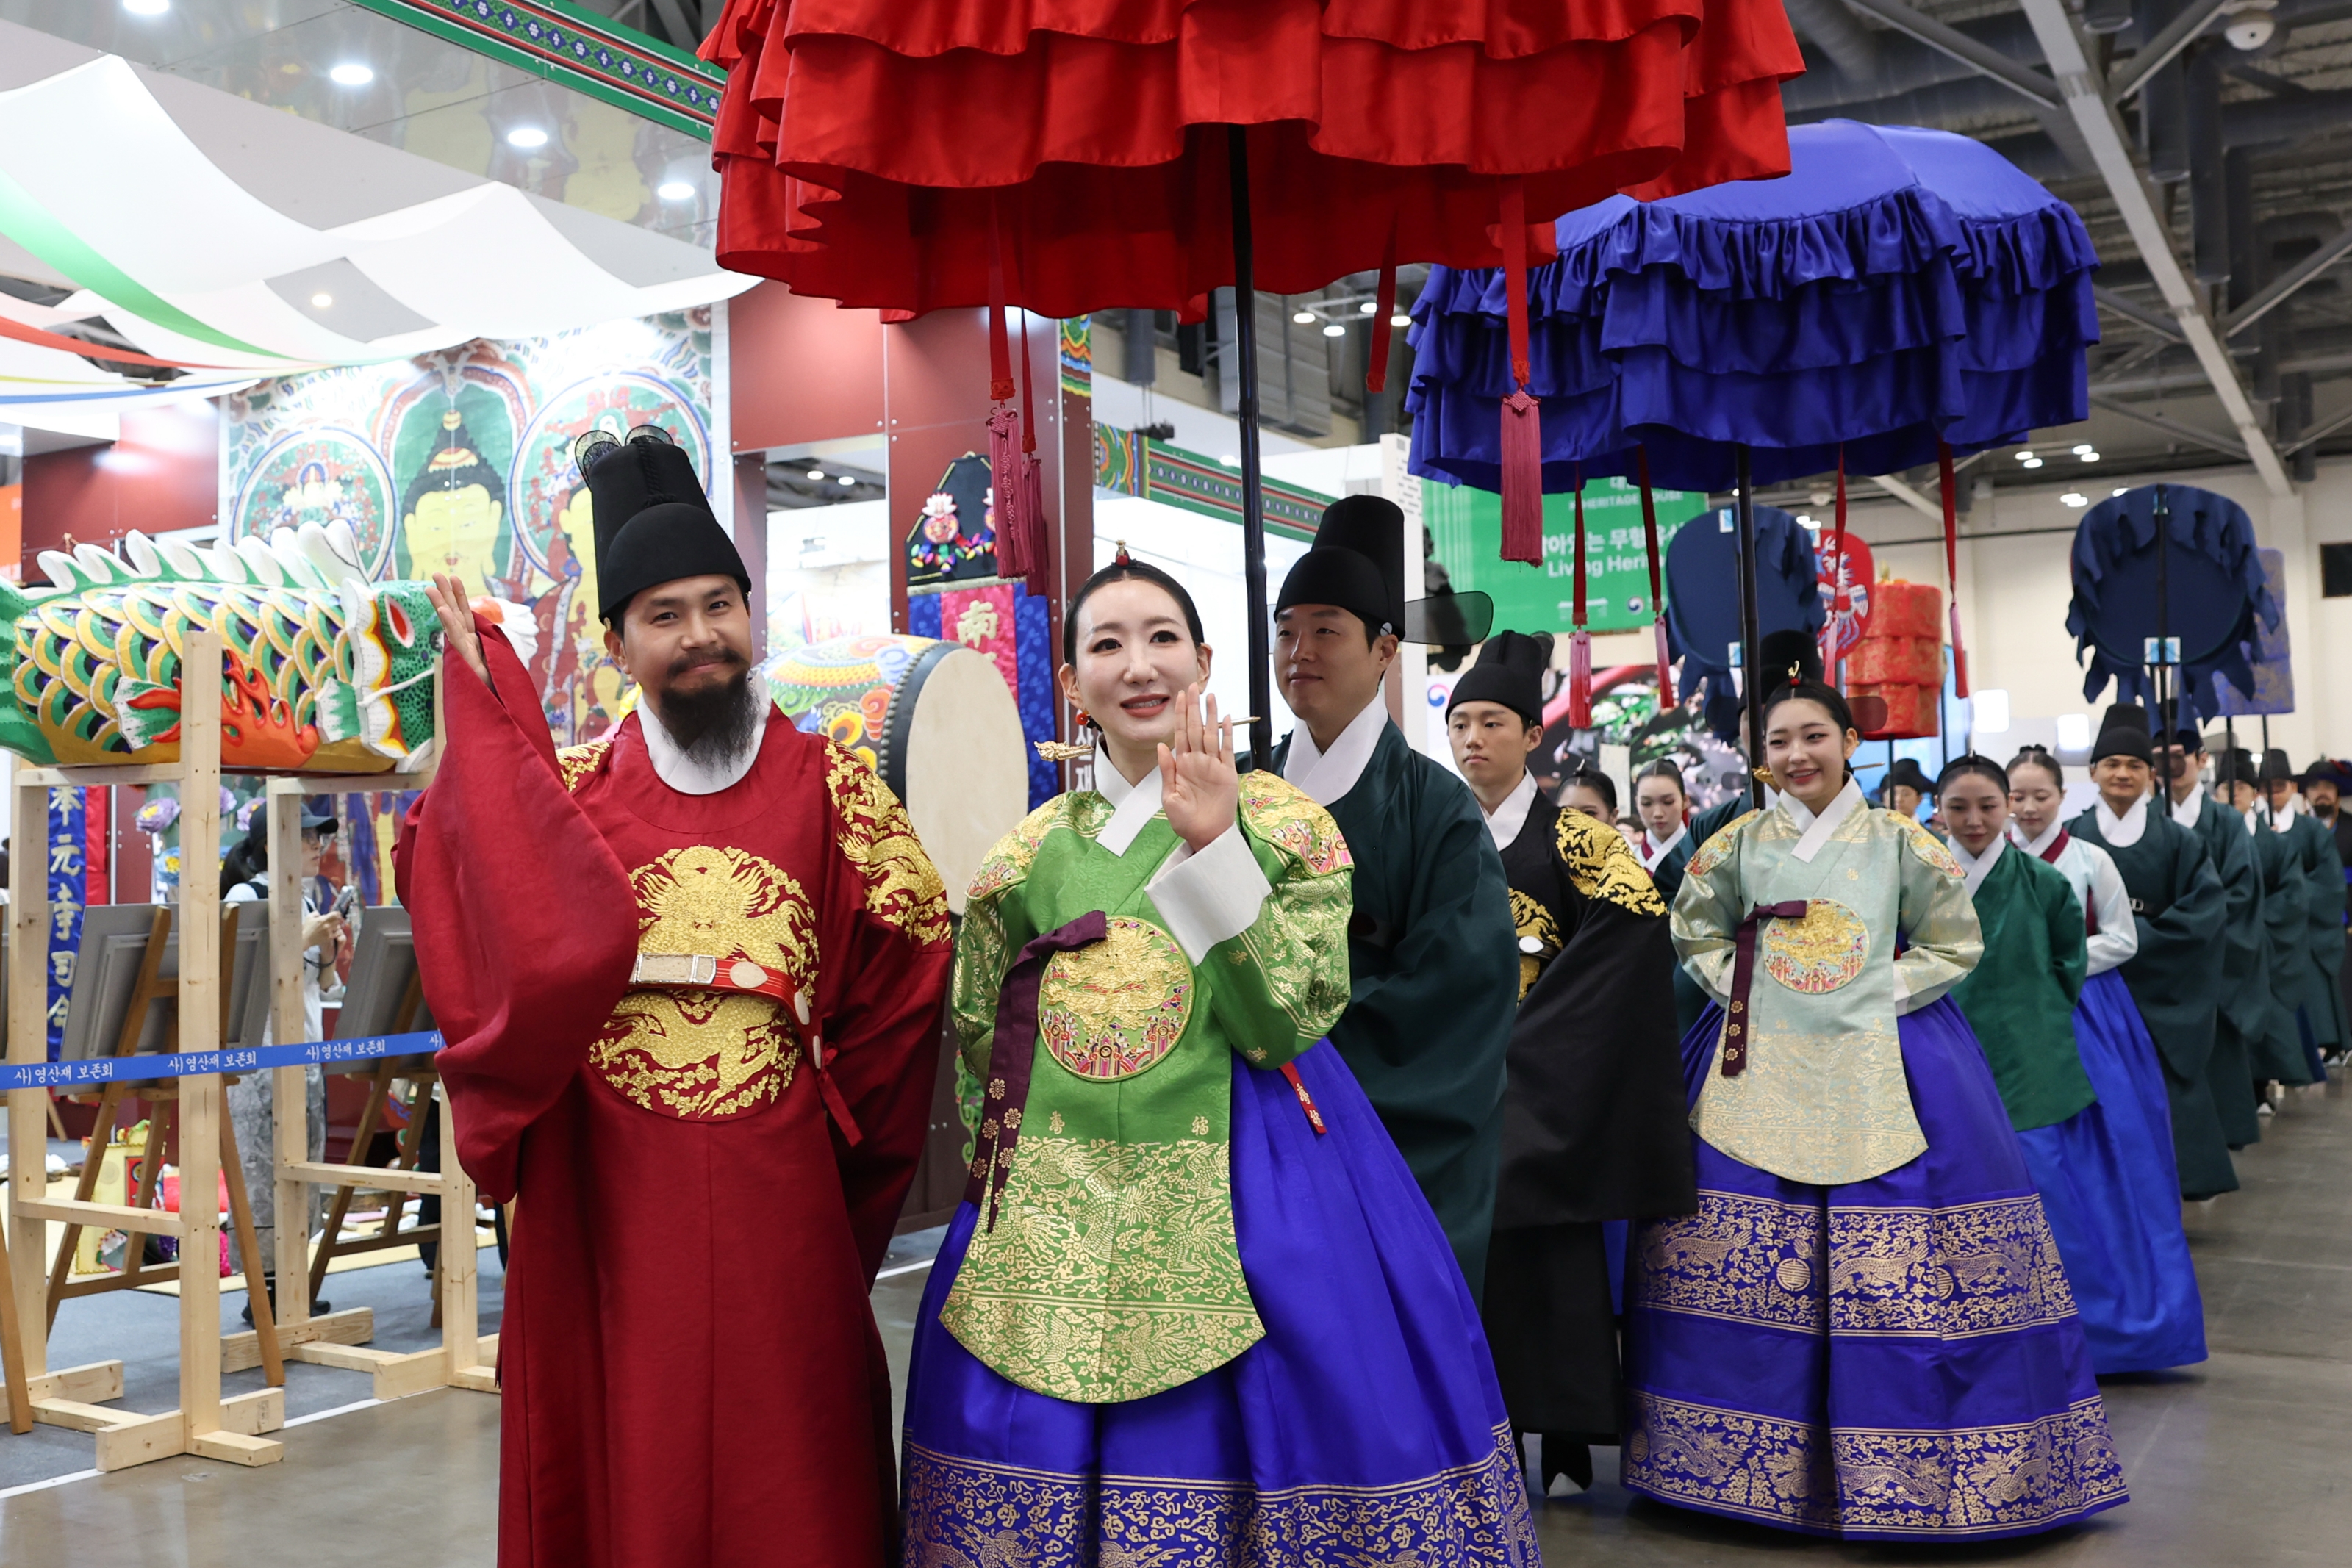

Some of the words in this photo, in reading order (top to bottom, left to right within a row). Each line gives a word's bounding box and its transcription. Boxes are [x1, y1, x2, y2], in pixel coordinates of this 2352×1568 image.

[356, 1038, 386, 1055] 보존회
[223, 1051, 257, 1068] 보존회
[76, 1062, 113, 1080] 보존회
